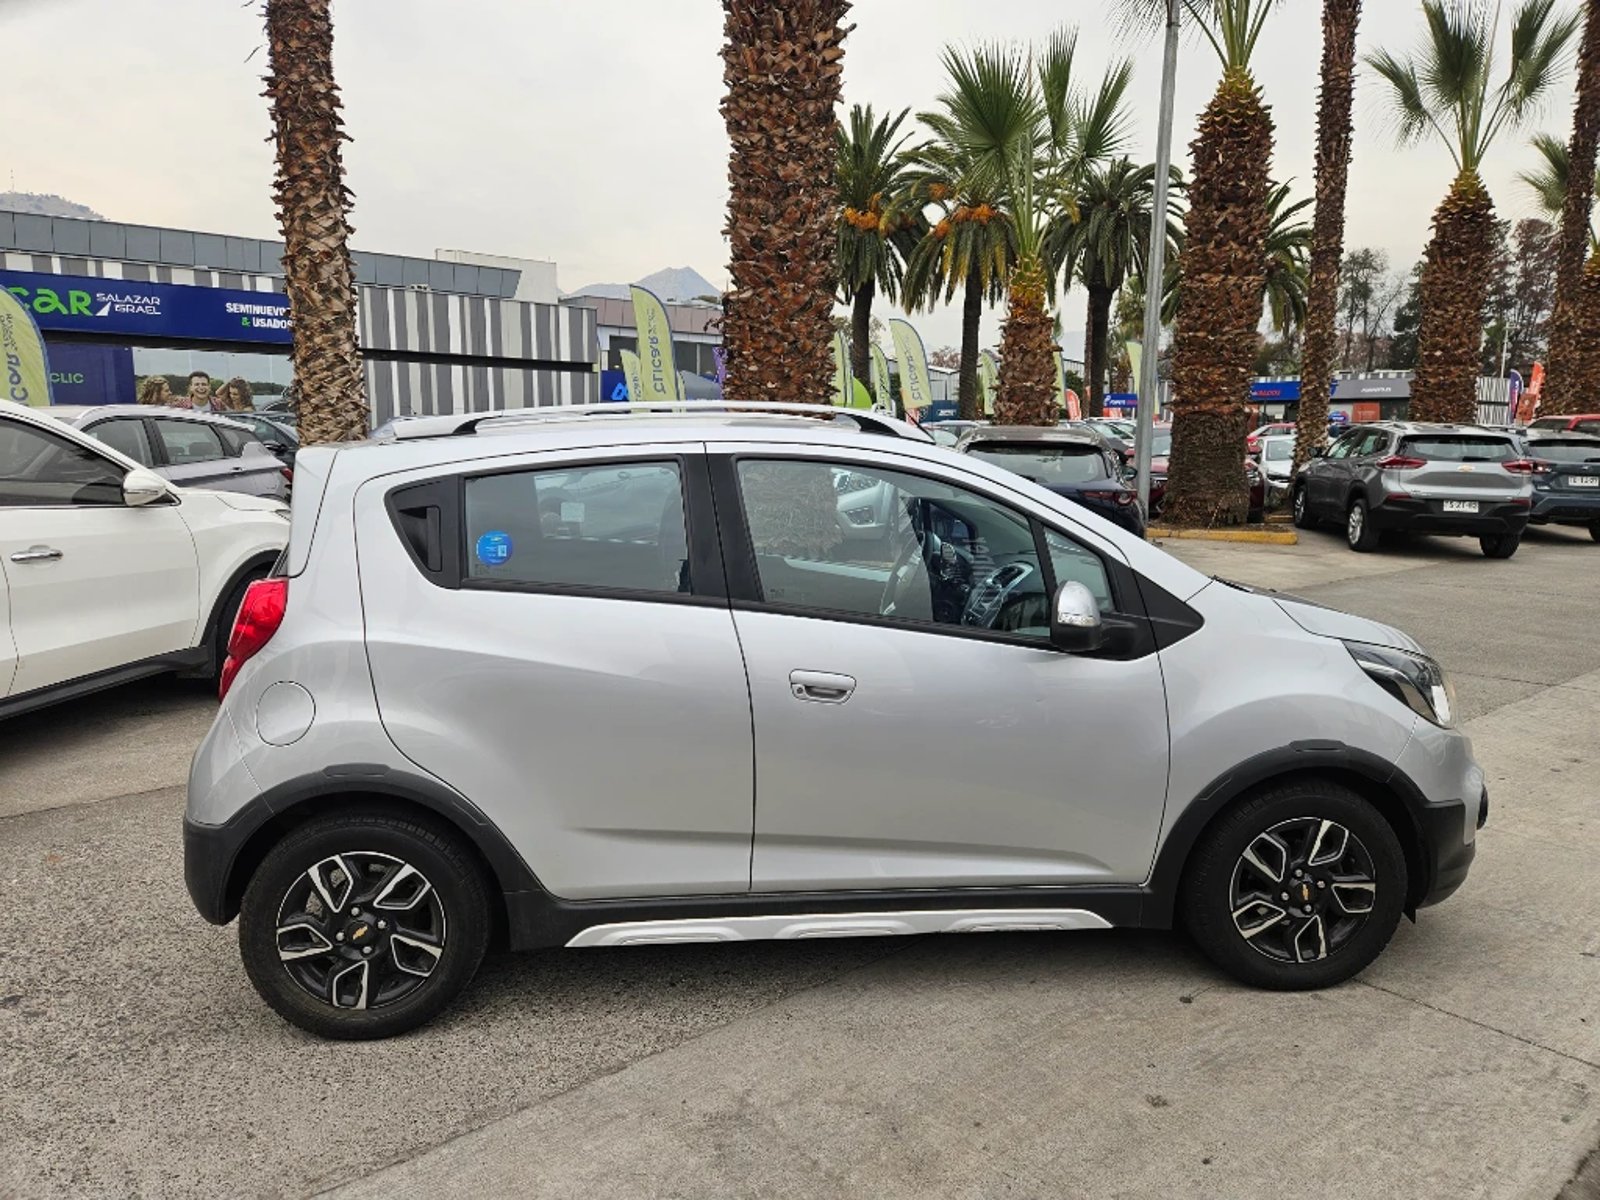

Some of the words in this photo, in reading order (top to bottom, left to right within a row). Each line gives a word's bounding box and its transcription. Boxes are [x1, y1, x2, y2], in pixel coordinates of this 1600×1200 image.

[96, 293, 160, 305] SALAZAR
[114, 303, 161, 315] ISRAEL
[225, 302, 291, 316] SEMINUEVO
